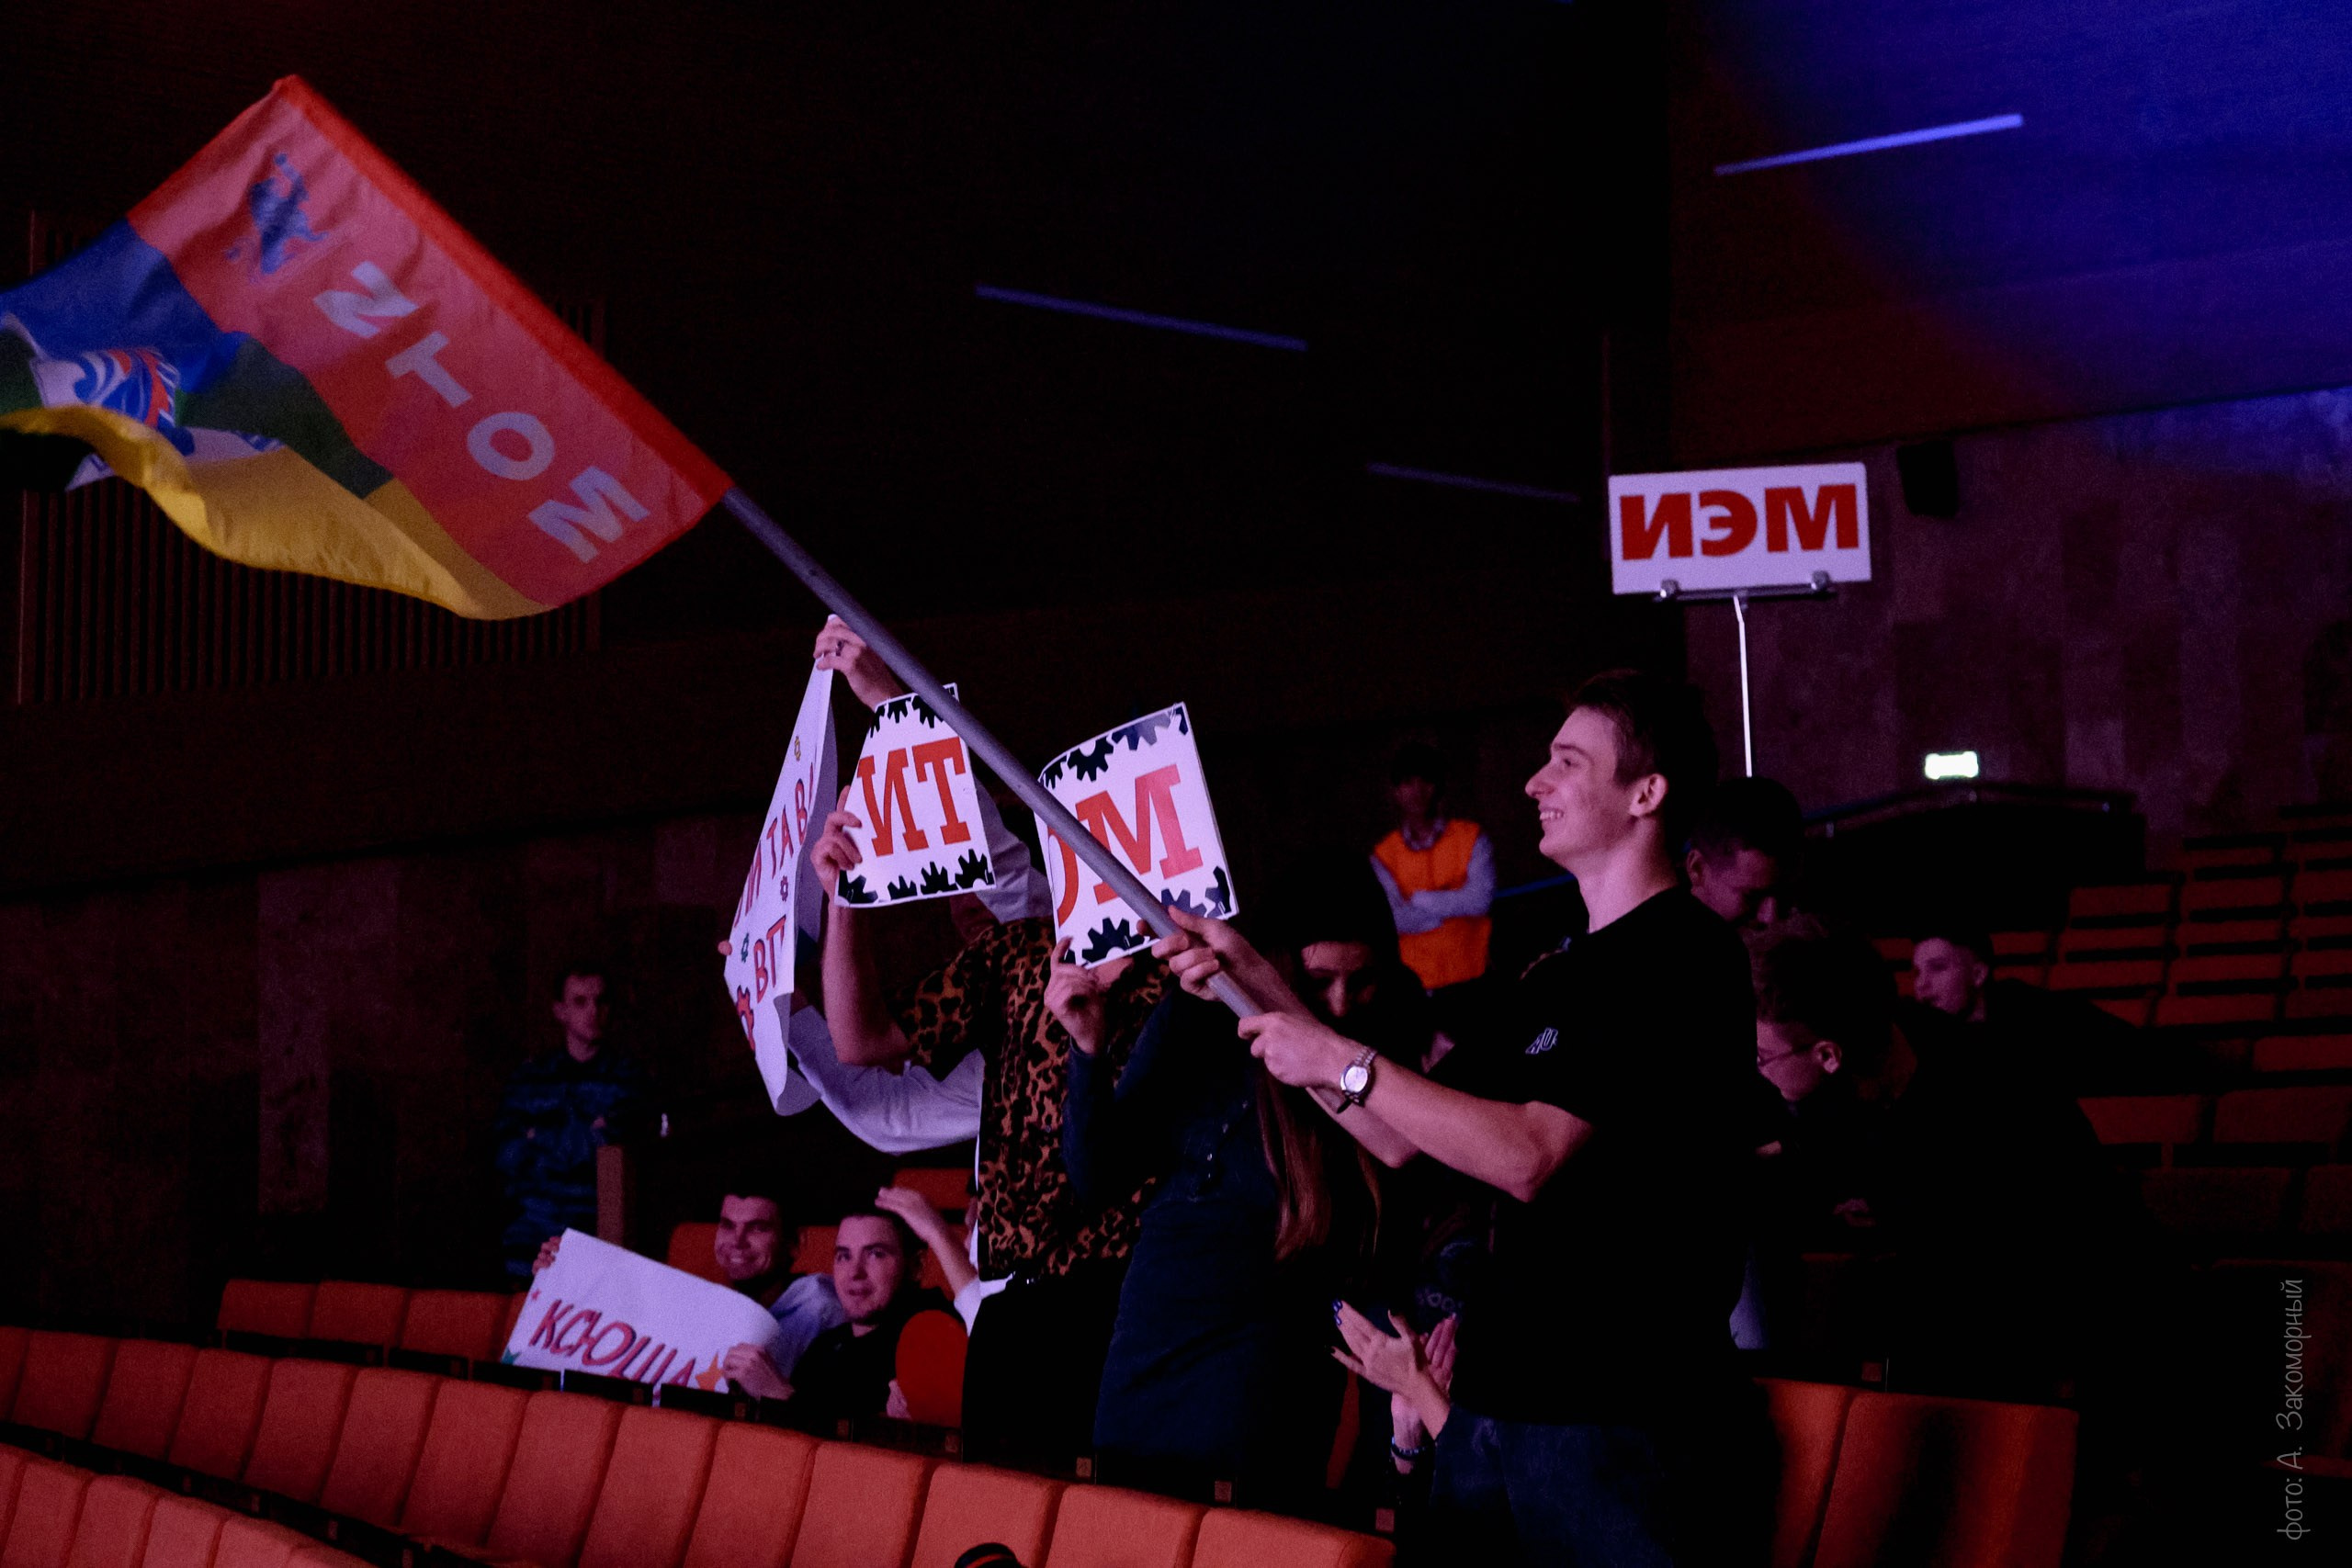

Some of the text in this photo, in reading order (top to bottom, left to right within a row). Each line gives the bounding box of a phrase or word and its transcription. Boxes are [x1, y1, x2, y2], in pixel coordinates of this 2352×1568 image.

[1620, 483, 1860, 561] ИЭМ
[856, 736, 971, 857] ИТ
[528, 1299, 696, 1387] КСЮША
